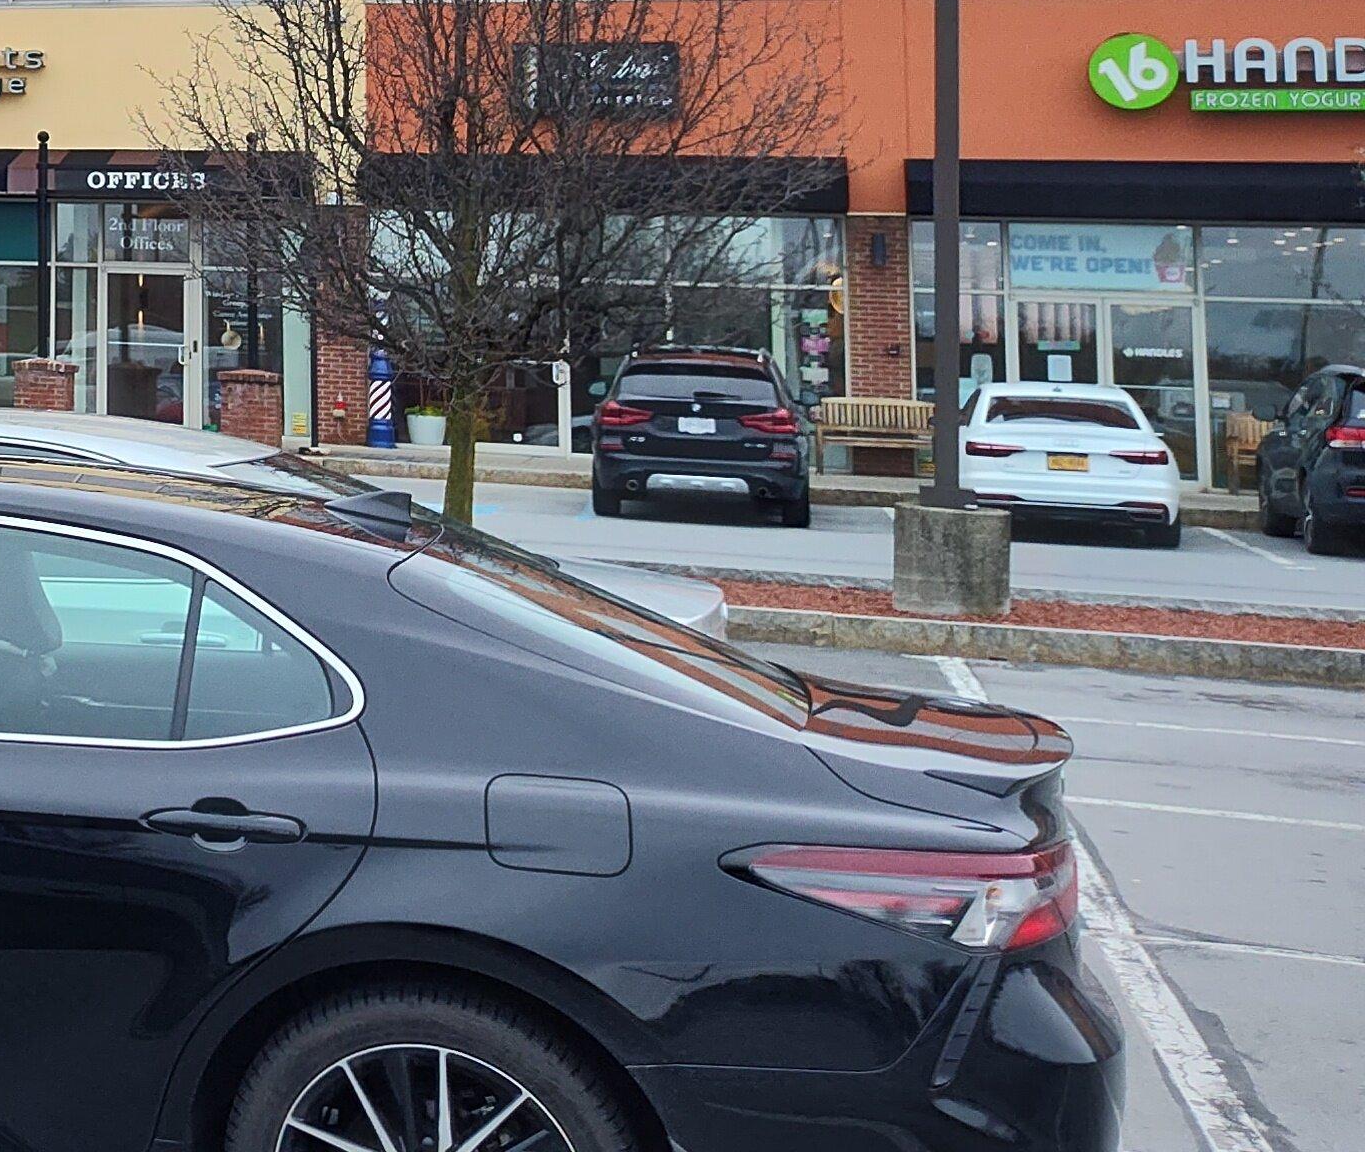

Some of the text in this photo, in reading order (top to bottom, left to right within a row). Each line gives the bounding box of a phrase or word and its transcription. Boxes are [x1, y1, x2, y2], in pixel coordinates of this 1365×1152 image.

[1098, 42, 1168, 102] 16
[1195, 91, 1365, 108] FROZEN YOGUR
[86, 170, 207, 190] OFFICES
[109, 217, 186, 233] 2nd Floor
[119, 235, 174, 251] Offices
[1010, 233, 1070, 252] COME
[1010, 255, 1154, 275] WE'RE OPEN!
